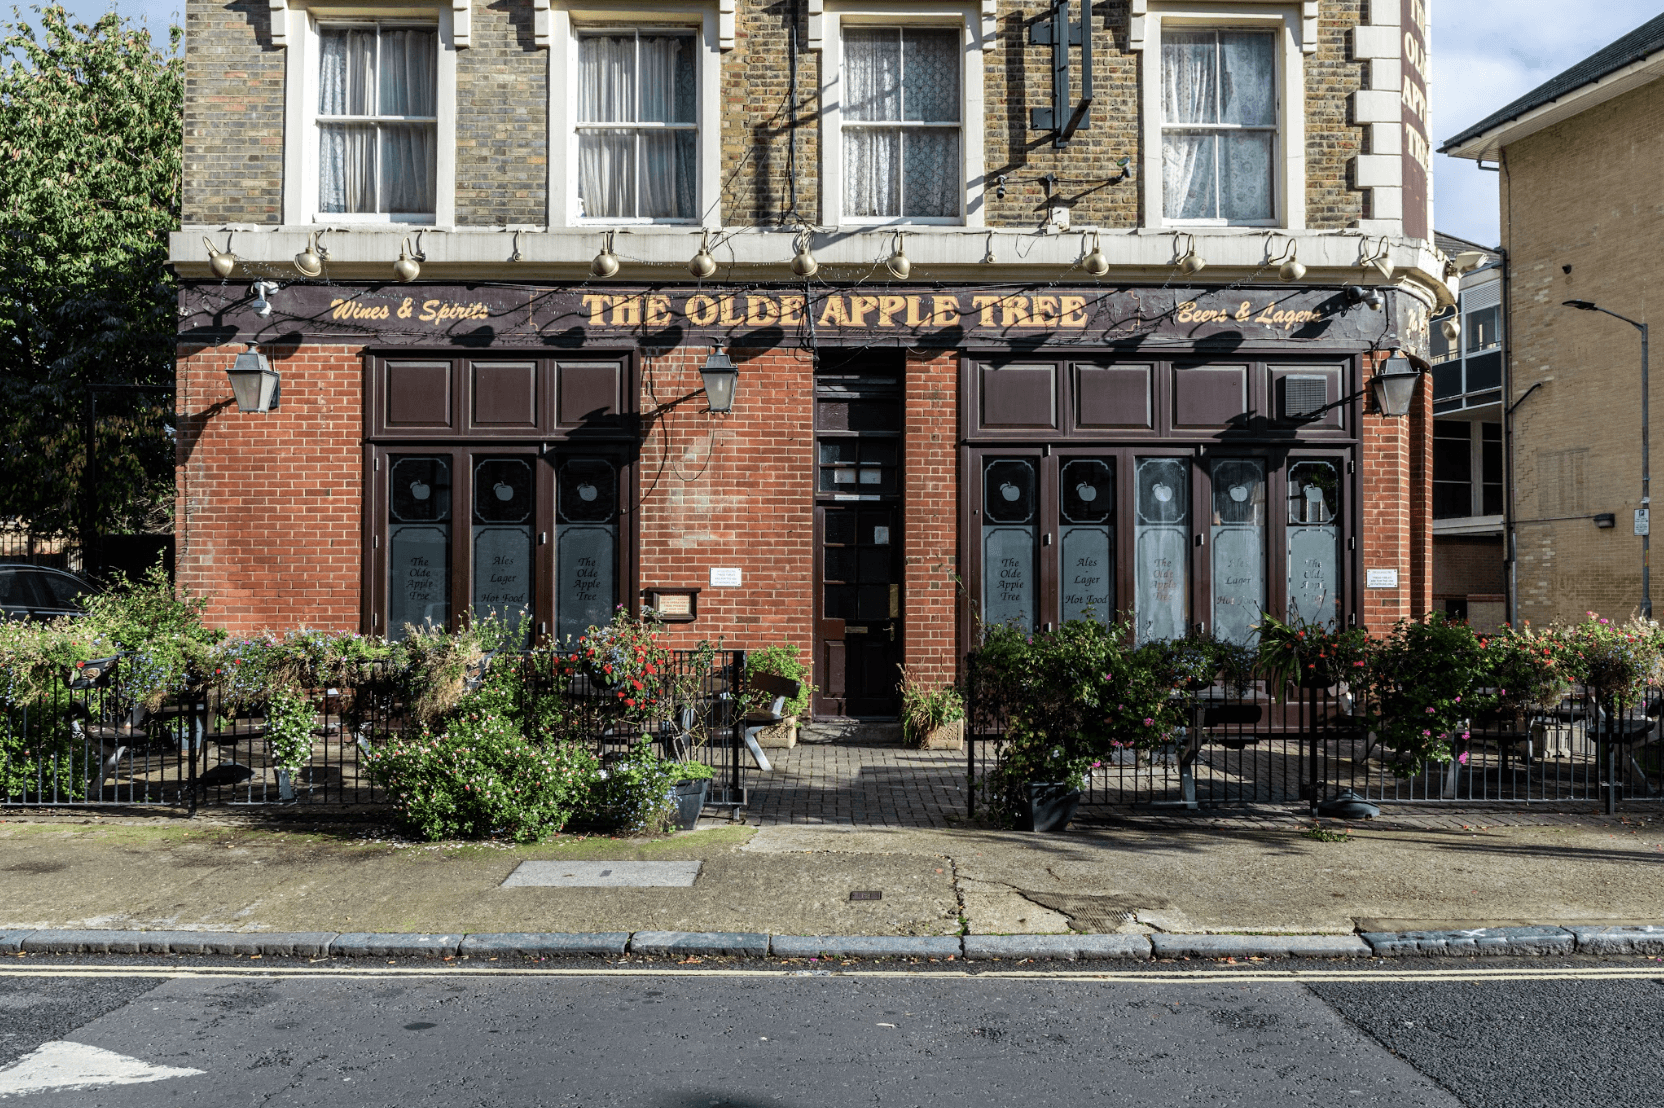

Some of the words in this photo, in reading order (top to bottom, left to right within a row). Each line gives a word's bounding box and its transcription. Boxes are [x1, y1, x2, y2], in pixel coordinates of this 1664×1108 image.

[331, 299, 390, 320] Wines
[397, 297, 413, 319] &
[419, 300, 489, 326] Spirits
[582, 294, 672, 327] THE
[685, 294, 807, 327] OLDE
[817, 295, 962, 328] APPLE
[972, 295, 1089, 328] TREE
[1177, 301, 1228, 323] Beers
[1234, 301, 1250, 323] &
[410, 556, 429, 567] The
[492, 555, 514, 565] Ales
[578, 556, 596, 567] The
[1001, 557, 1020, 568] The
[1076, 556, 1098, 567] Ales
[1153, 557, 1172, 568] The
[409, 567, 430, 577] Olde
[576, 567, 598, 578] Olde
[1000, 567, 1022, 579] Olde
[405, 578, 434, 591] Apple
[490, 573, 517, 586] Lager
[572, 578, 601, 591] Apple
[996, 578, 1024, 592] Apple
[1073, 575, 1101, 587] Lager
[409, 591, 430, 600] Tree
[481, 592, 500, 603] Hot
[502, 592, 526, 604] Food
[576, 591, 597, 601] Tree
[1000, 591, 1021, 602] Tree
[1064, 594, 1084, 604] Hot
